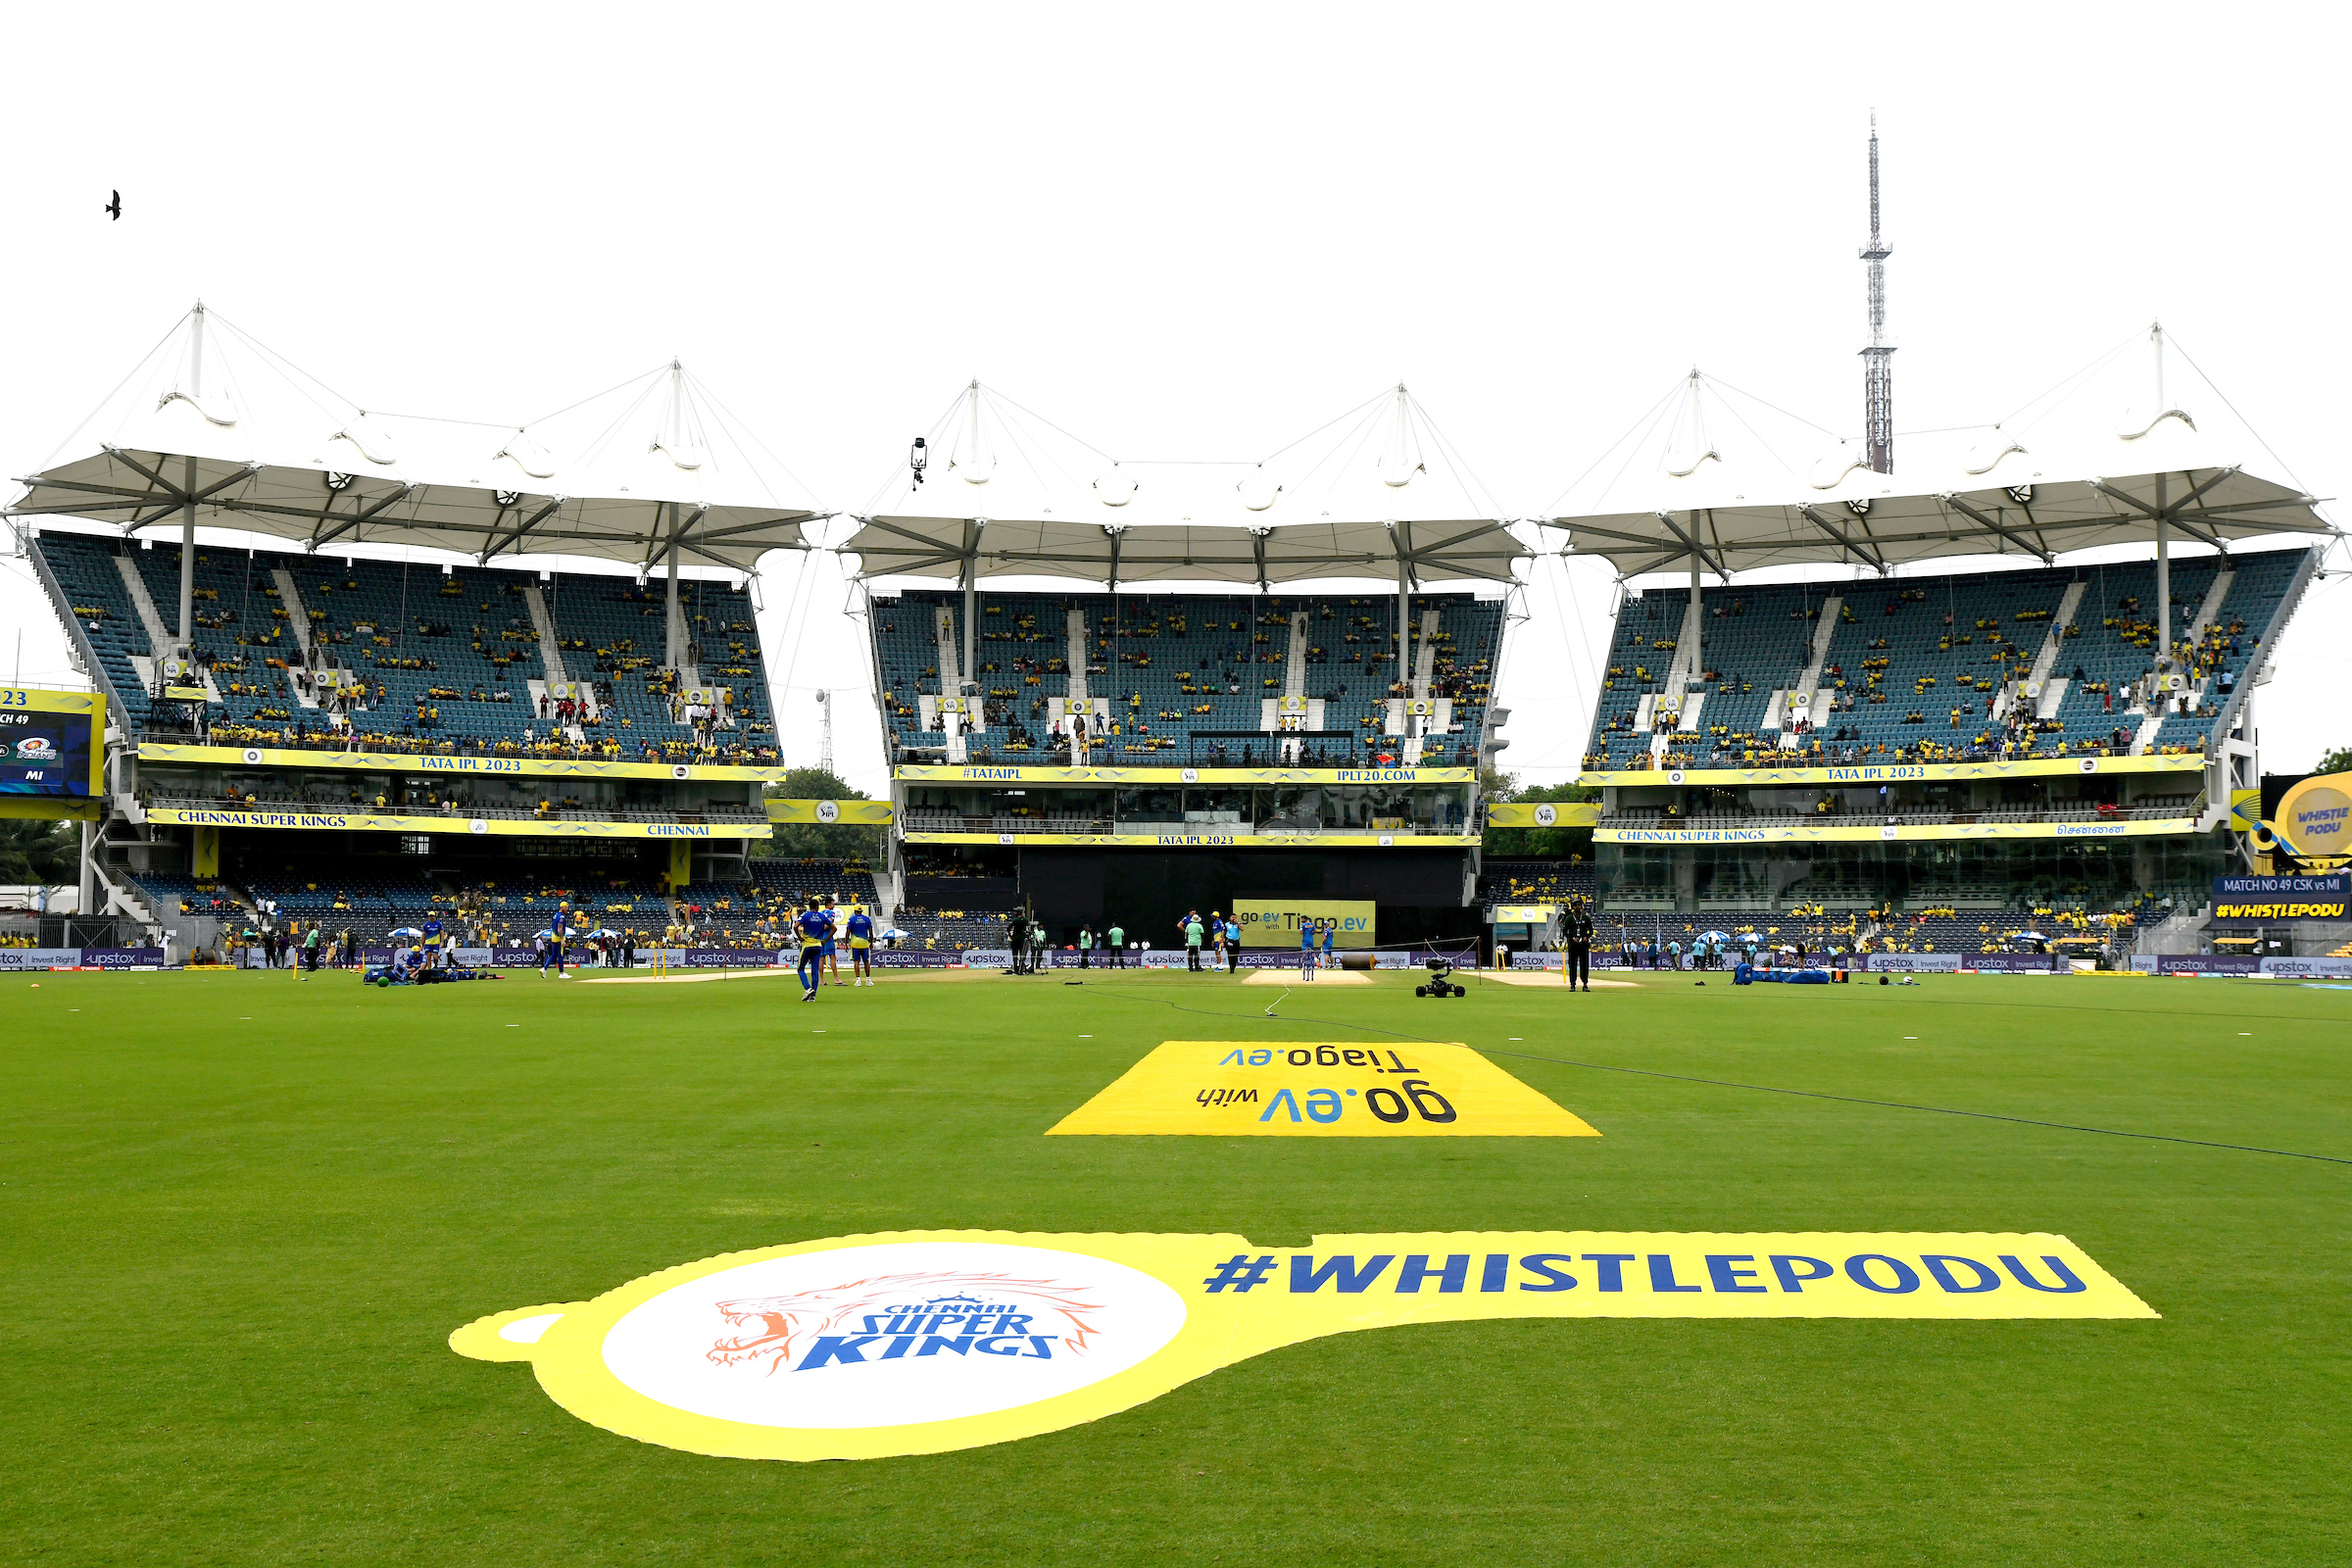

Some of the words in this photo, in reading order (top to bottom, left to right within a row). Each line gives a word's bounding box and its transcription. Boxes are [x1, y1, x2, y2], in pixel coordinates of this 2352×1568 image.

[0, 690, 26, 706] 23
[0, 714, 14, 724] CH
[16, 715, 29, 724] 49
[419, 757, 454, 769] TATA
[458, 759, 480, 770] IPL
[485, 759, 521, 771] 2023
[25, 771, 43, 780] MI
[963, 769, 1022, 779] #TATAIPL
[1337, 770, 1416, 782] IPLT20.COM
[1827, 768, 1861, 780] TATA
[1864, 767, 1885, 779] IPL
[1889, 766, 1925, 778] 2023
[177, 812, 245, 824] CHENNAI
[251, 814, 296, 826] SUPER
[301, 816, 346, 827] KINGS
[2297, 807, 2349, 822] WHISTLE
[647, 825, 710, 836] CHENNAI
[2057, 824, 2125, 834] சென்னை
[2305, 822, 2342, 835] PODU
[1157, 836, 1183, 844] TATA
[1187, 836, 1203, 844] IPL
[1207, 836, 1234, 844] 2023
[1618, 831, 1676, 842] CHENNAI
[1680, 830, 1720, 841] SUPER
[1724, 830, 1765, 841] KINGS
[2224, 880, 2259, 891] MATCH
[2262, 880, 2277, 891] NO
[2279, 880, 2291, 890] 49
[2293, 879, 2313, 890] CSK
[2327, 879, 2340, 890] MI
[2216, 903, 2345, 919] #WHISTLEPODU
[1241, 912, 1279, 924] go.ev
[0, 953, 23, 964] tox
[55, 956, 75, 965] Right
[86, 953, 136, 966] upstox
[373, 955, 390, 963] Right
[689, 953, 730, 965] upstox
[758, 955, 773, 964] Right
[875, 954, 915, 966] upstox
[966, 954, 1005, 965] upstox
[1146, 955, 1185, 965] upstox
[1238, 954, 1274, 965] upstox
[1873, 956, 1913, 969] upstox
[1941, 960, 1957, 969] Right
[1966, 958, 2008, 970] upstox
[2037, 961, 2052, 969] Righ
[2135, 962, 2152, 970] Right
[2162, 959, 2207, 972] upstox
[2237, 963, 2255, 971] Right
[2265, 961, 2312, 974] upstox
[2343, 965, 2352, 973] Rig
[1219, 1045, 1420, 1074] Tiago.ev
[1196, 1089, 1258, 1107] with
[1259, 1079, 1457, 1123] go.ev
[1203, 1254, 2088, 1294] #WHISTLEPODU
[884, 1304, 1017, 1313] CHENNAI
[850, 1314, 1033, 1334] SUPER
[790, 1335, 1058, 1372] KINGS
